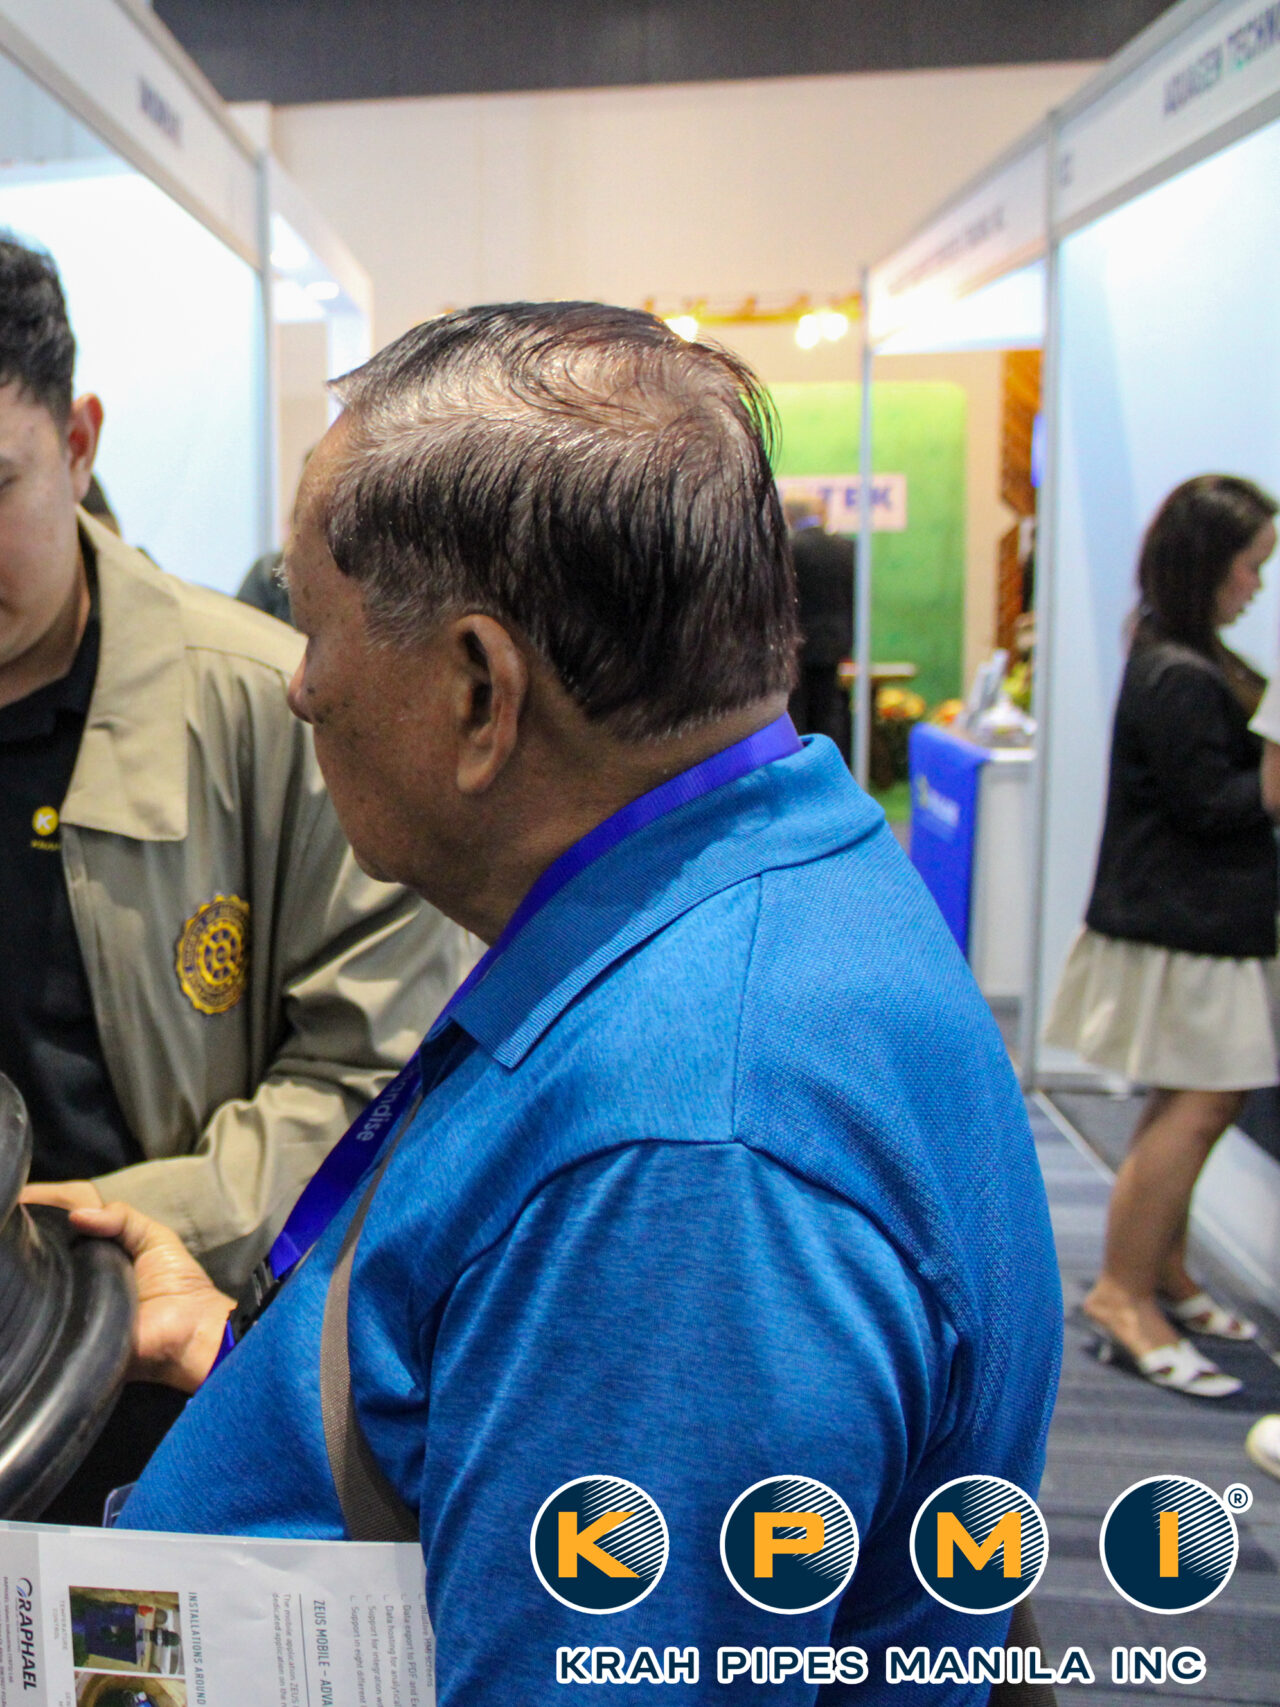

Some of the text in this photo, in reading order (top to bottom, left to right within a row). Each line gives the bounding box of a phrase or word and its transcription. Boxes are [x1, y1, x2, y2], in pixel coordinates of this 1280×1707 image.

[313, 1599, 327, 1626] ZEUS
[351, 1606, 360, 1638] Support
[368, 1605, 378, 1637] Support
[385, 1605, 394, 1624] Data
[403, 1604, 412, 1623] Data
[19, 1597, 37, 1691] RAPHAEL
[188, 1591, 207, 1706] INSTALLATIONS AROUND
[316, 1628, 330, 1667] MOBILE
[386, 1625, 396, 1655] hosting
[404, 1625, 414, 1650] export
[320, 1678, 334, 1707] ADVA
